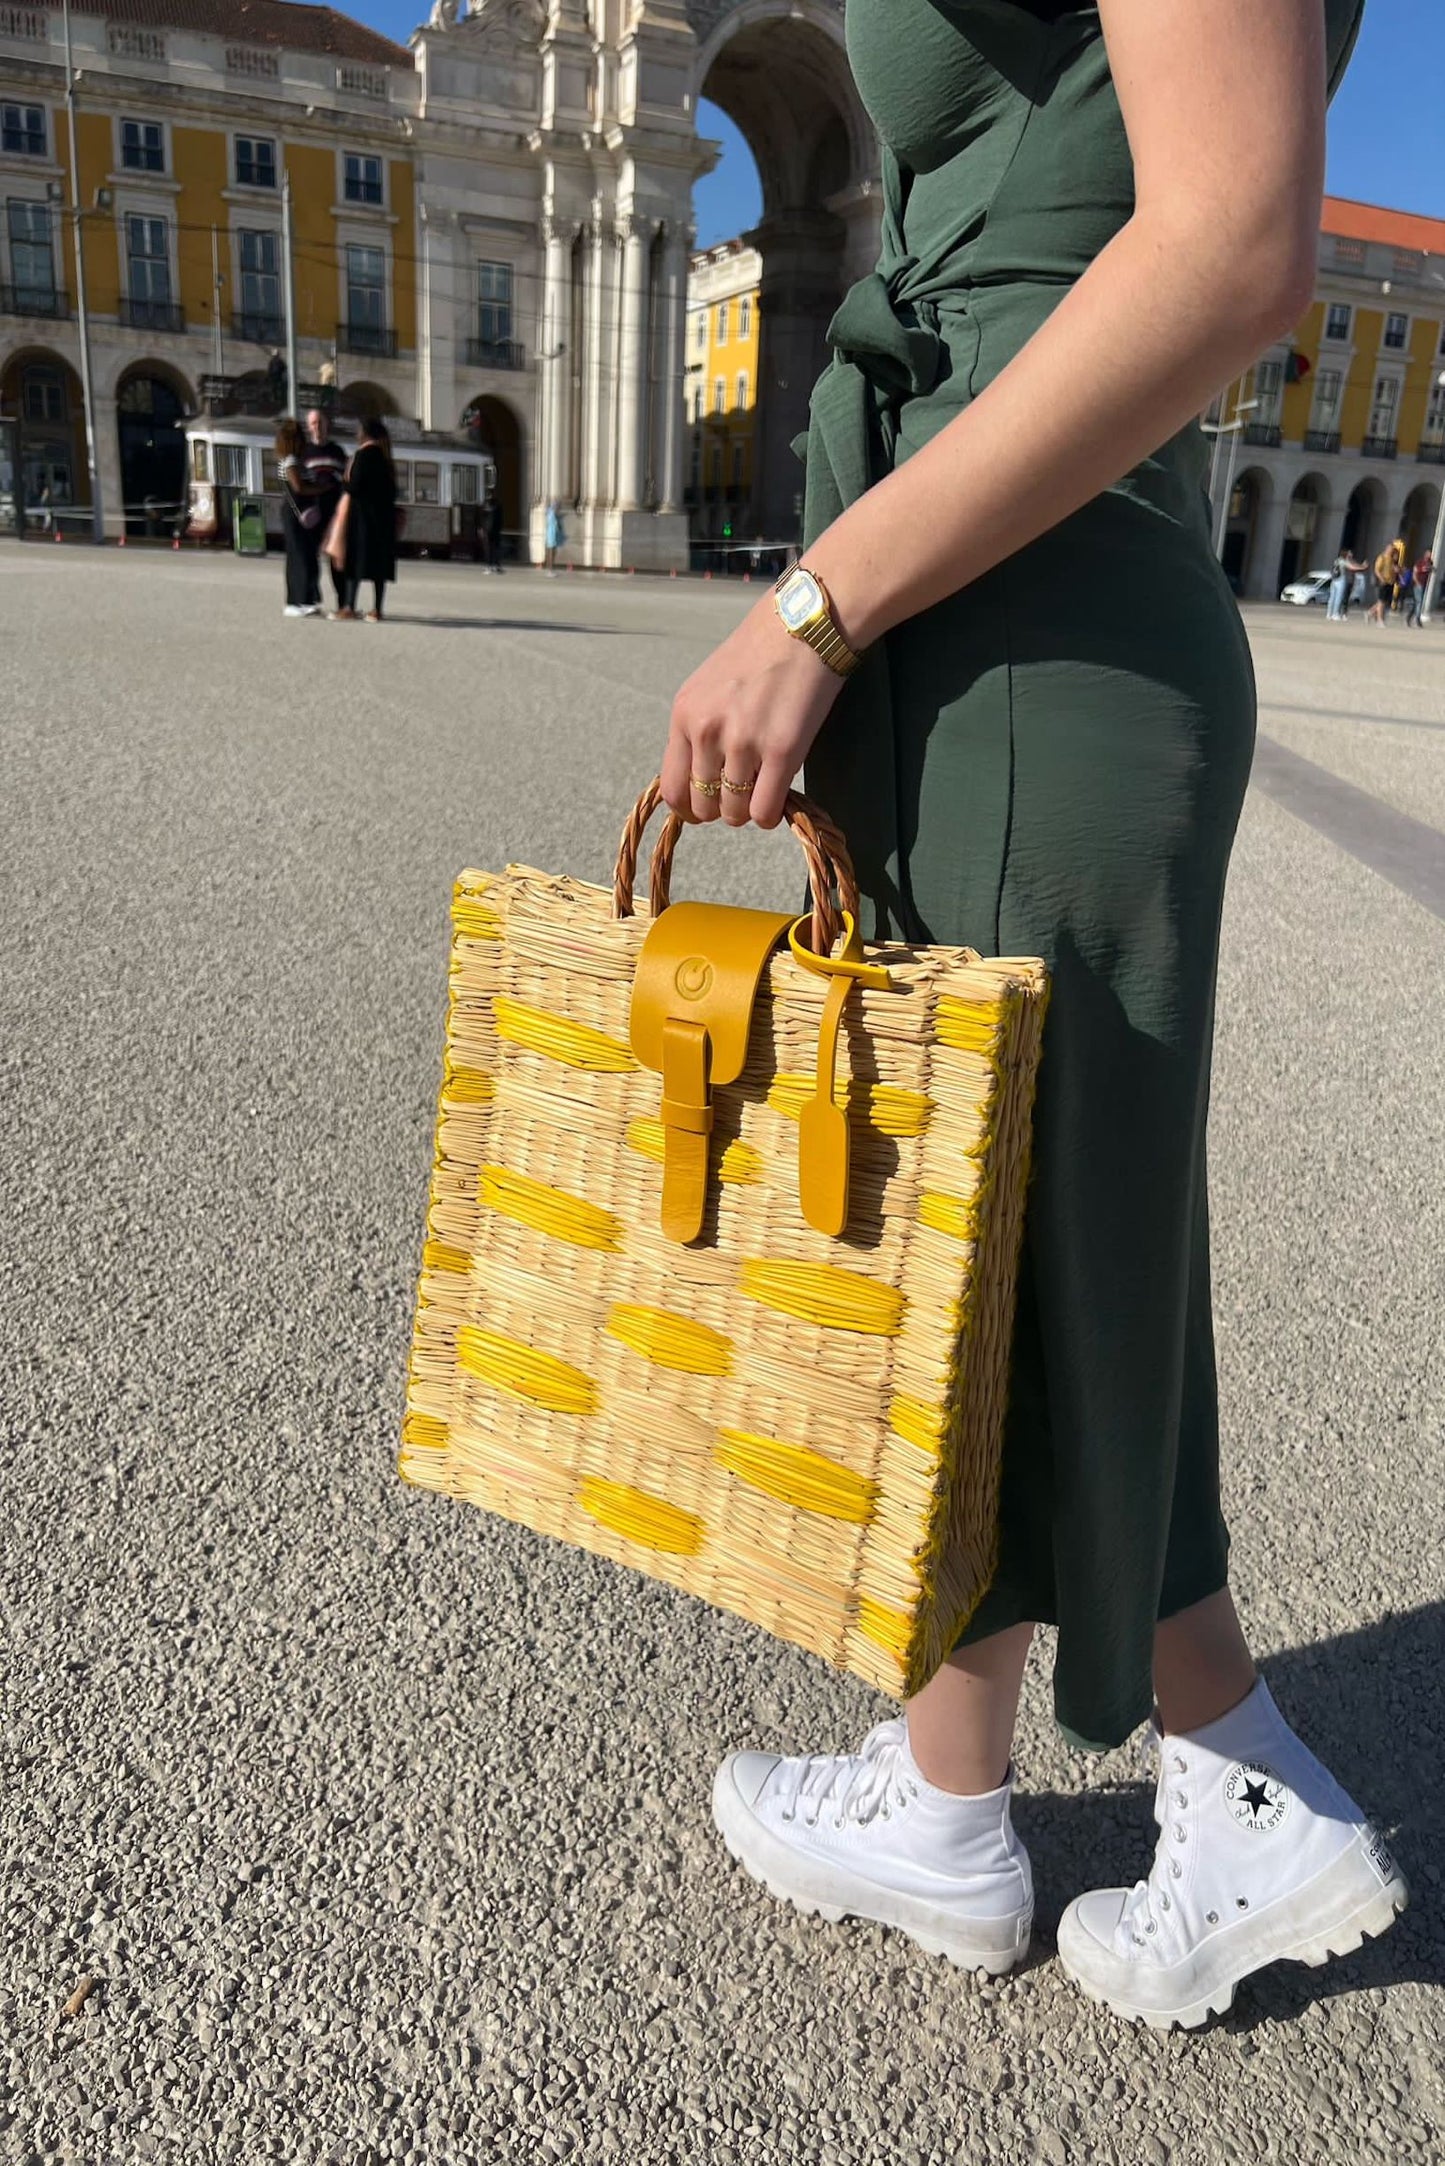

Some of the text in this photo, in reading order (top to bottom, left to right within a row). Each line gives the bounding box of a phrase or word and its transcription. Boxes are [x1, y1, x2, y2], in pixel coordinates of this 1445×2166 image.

[1226, 1763, 1271, 1800] CONVERSE
[1246, 1819, 1267, 1830] ALL
[1267, 1801, 1286, 1828] STAR
